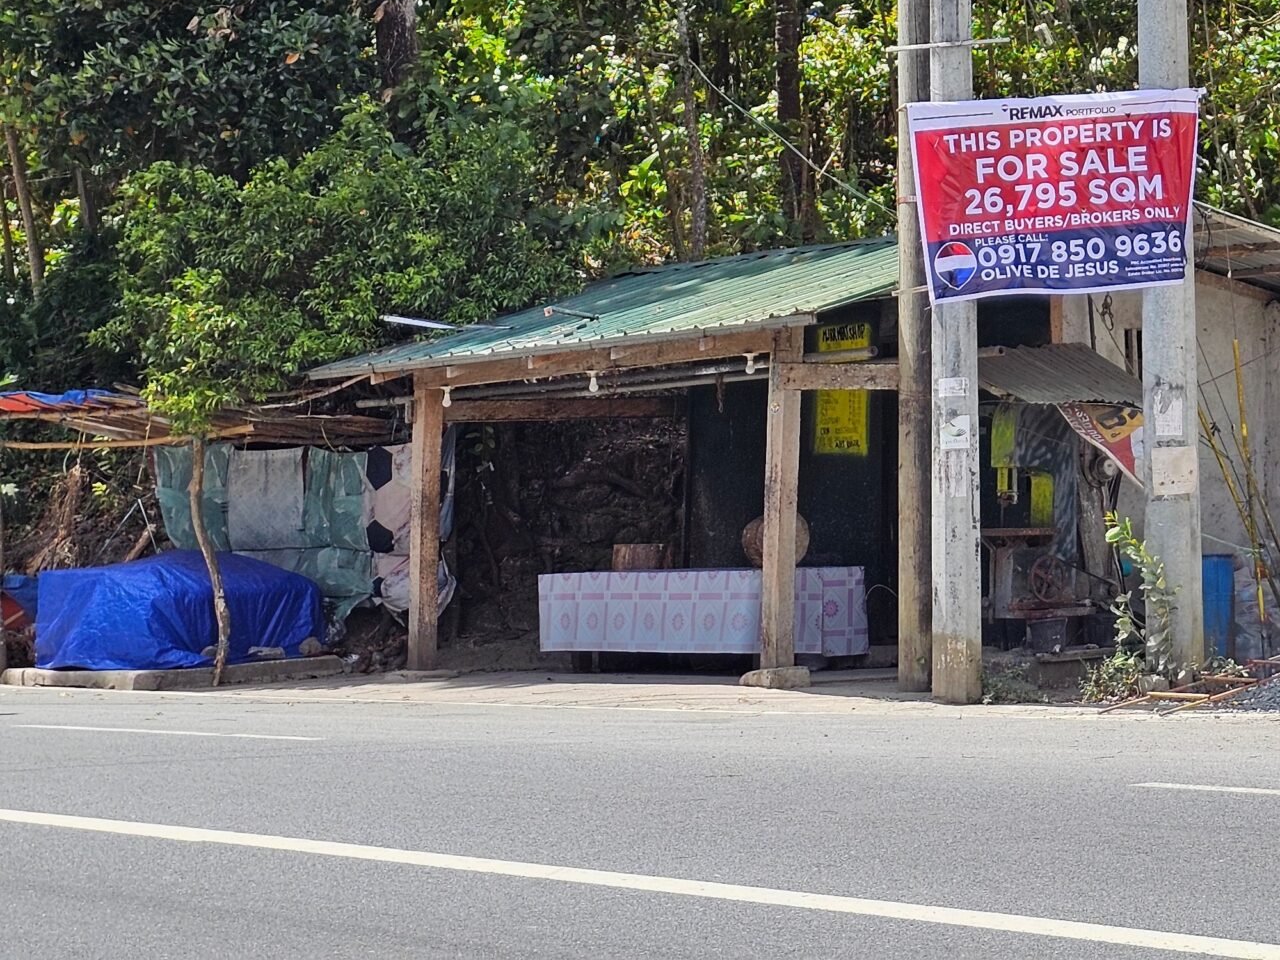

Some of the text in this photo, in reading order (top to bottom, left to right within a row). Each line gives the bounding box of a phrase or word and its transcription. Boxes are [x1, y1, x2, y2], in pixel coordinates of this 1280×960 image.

[1009, 105, 1116, 120] REMAX PORTFOLIO
[943, 119, 1172, 154] THIS PROPERTY IS
[975, 145, 1148, 184] FOR SALE
[964, 174, 1163, 217] 26,795 SQM
[949, 206, 1180, 236] DIRECT BUYERS/BROKERS ONLY
[974, 233, 1049, 247] PLEASE CALL:
[978, 230, 1182, 267] 0917 850 9636
[981, 260, 1119, 280] OLIVE DE JESUS
